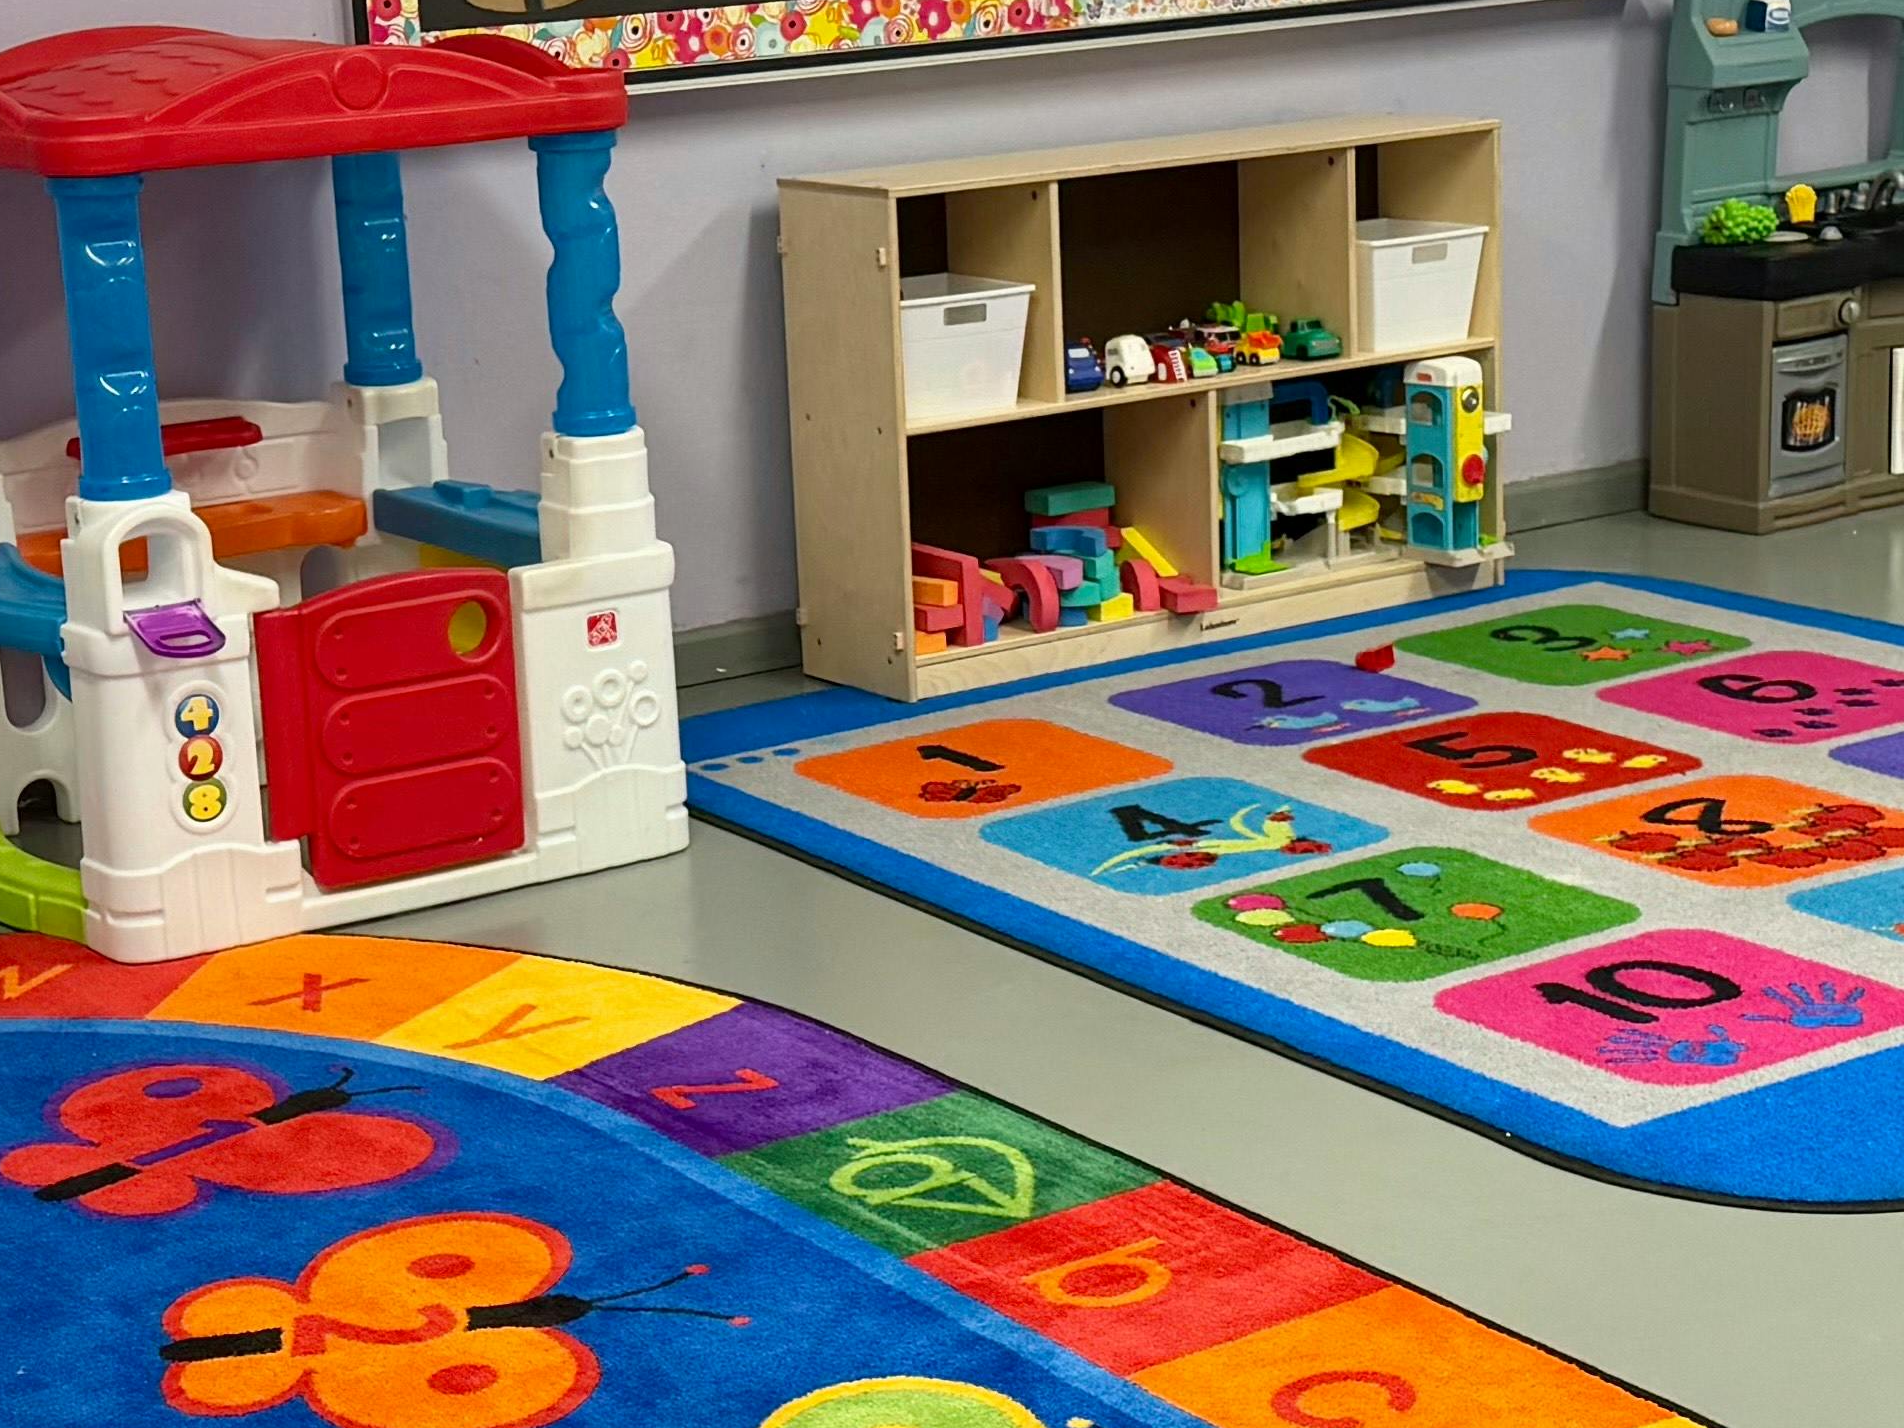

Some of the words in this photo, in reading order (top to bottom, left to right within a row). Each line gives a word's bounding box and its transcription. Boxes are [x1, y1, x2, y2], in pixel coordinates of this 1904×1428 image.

[1488, 624, 1595, 651] 3
[1211, 677, 1325, 710] 2
[1696, 673, 1815, 705] 6
[180, 696, 214, 731] 4
[187, 739, 215, 775] 2
[917, 743, 1006, 773] 1
[1406, 730, 1538, 771] 5
[188, 784, 222, 820] 8
[1637, 796, 1773, 836] 8
[1110, 804, 1223, 843] 4
[1307, 877, 1426, 922] 7
[248, 973, 370, 1012] x
[1534, 960, 1744, 1025] 10
[442, 1004, 590, 1050] y
[651, 1067, 779, 1112] z
[131, 1118, 256, 1166] 1
[1022, 1236, 1174, 1309] b
[289, 1303, 456, 1356] 2
